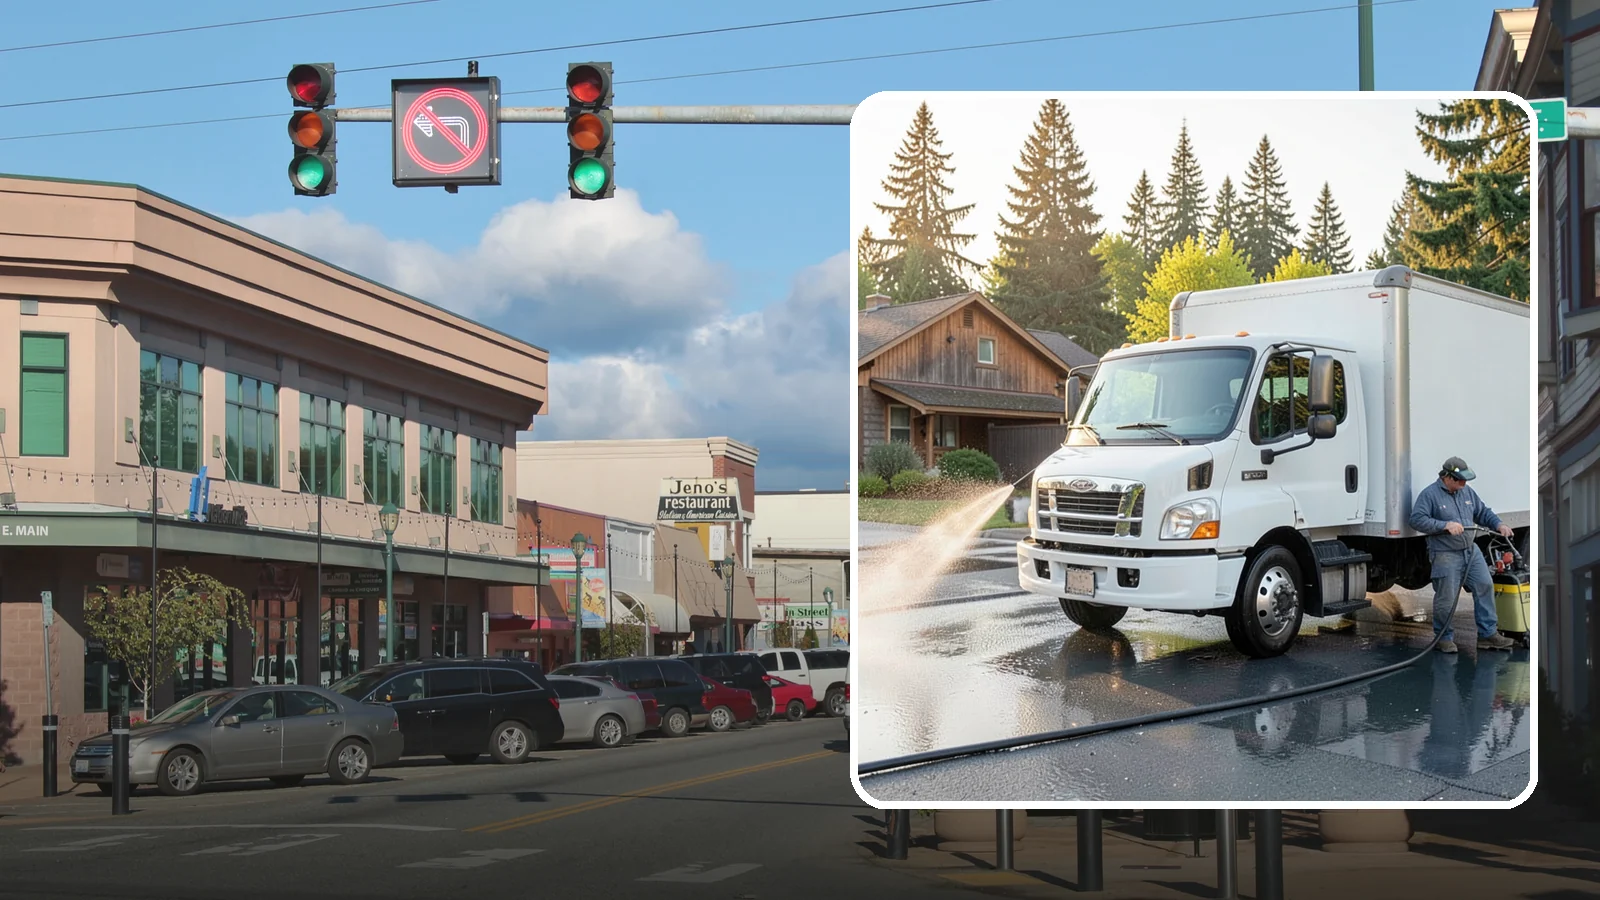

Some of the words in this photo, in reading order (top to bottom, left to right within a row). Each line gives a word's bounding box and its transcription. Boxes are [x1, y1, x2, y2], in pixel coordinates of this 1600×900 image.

[669, 480, 727, 495] Jeno's
[665, 496, 731, 509] restaurant
[686, 509, 714, 520] American
[715, 509, 737, 520] Cuisine
[2, 525, 13, 536] E.
[15, 525, 49, 536] MAIN
[797, 607, 829, 616] Street
